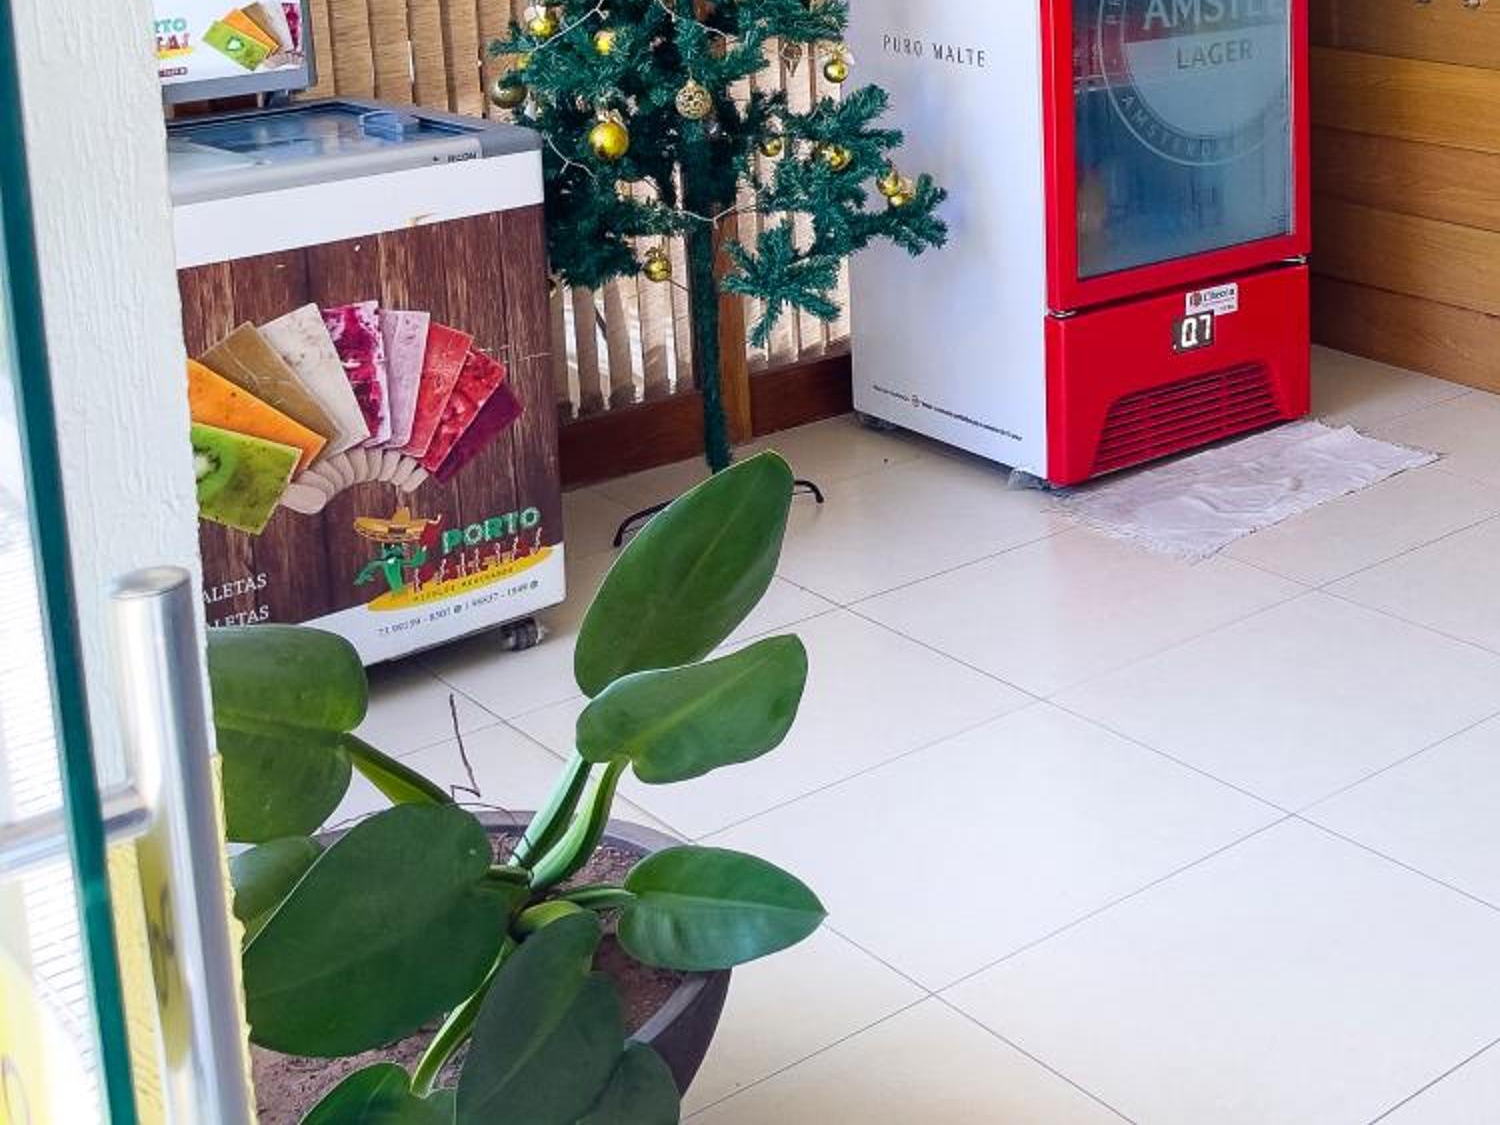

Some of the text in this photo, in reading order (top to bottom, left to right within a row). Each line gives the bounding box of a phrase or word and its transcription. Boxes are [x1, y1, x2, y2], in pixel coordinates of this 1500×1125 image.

[883, 34, 986, 68] PURO MALTE
[1176, 39, 1254, 69] LAGER
[441, 506, 541, 556] PORTO
